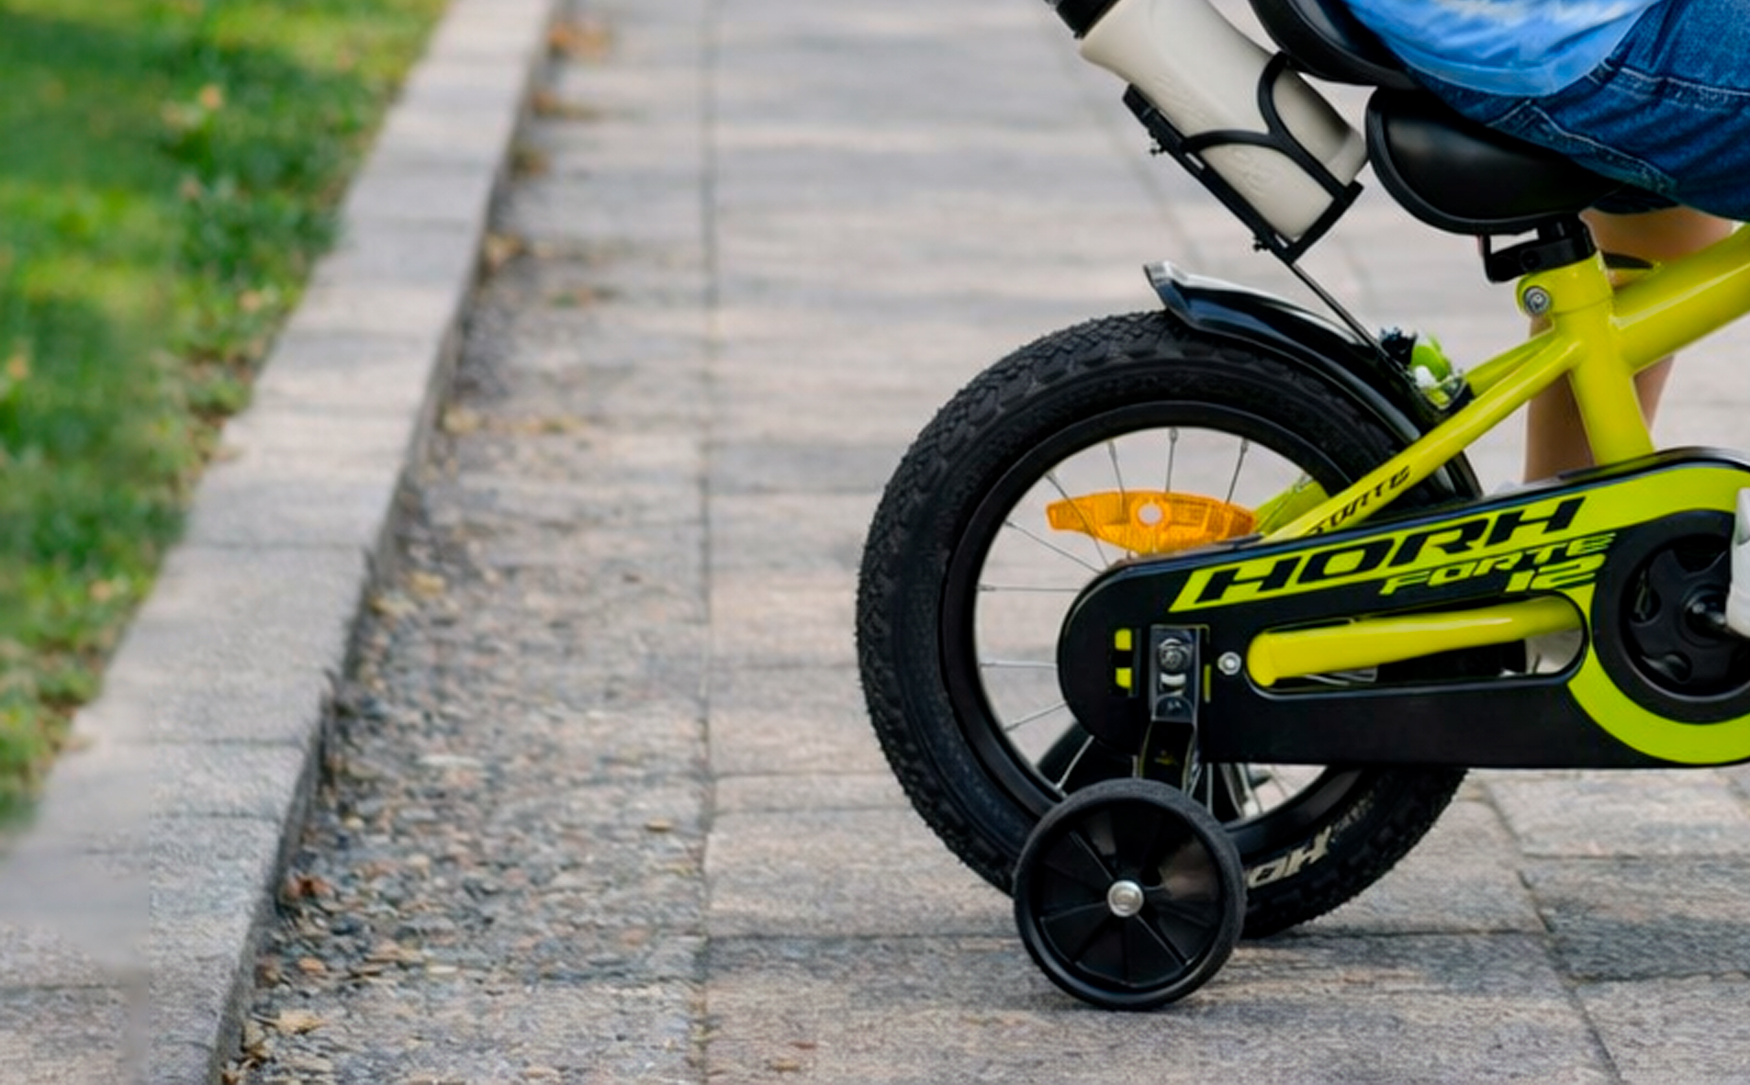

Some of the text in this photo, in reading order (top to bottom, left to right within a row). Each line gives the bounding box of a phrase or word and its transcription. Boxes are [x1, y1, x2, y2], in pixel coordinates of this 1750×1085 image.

[1195, 496, 1585, 605] HORH
[1379, 532, 1617, 595] FORTE
[1505, 552, 1606, 593] 12
